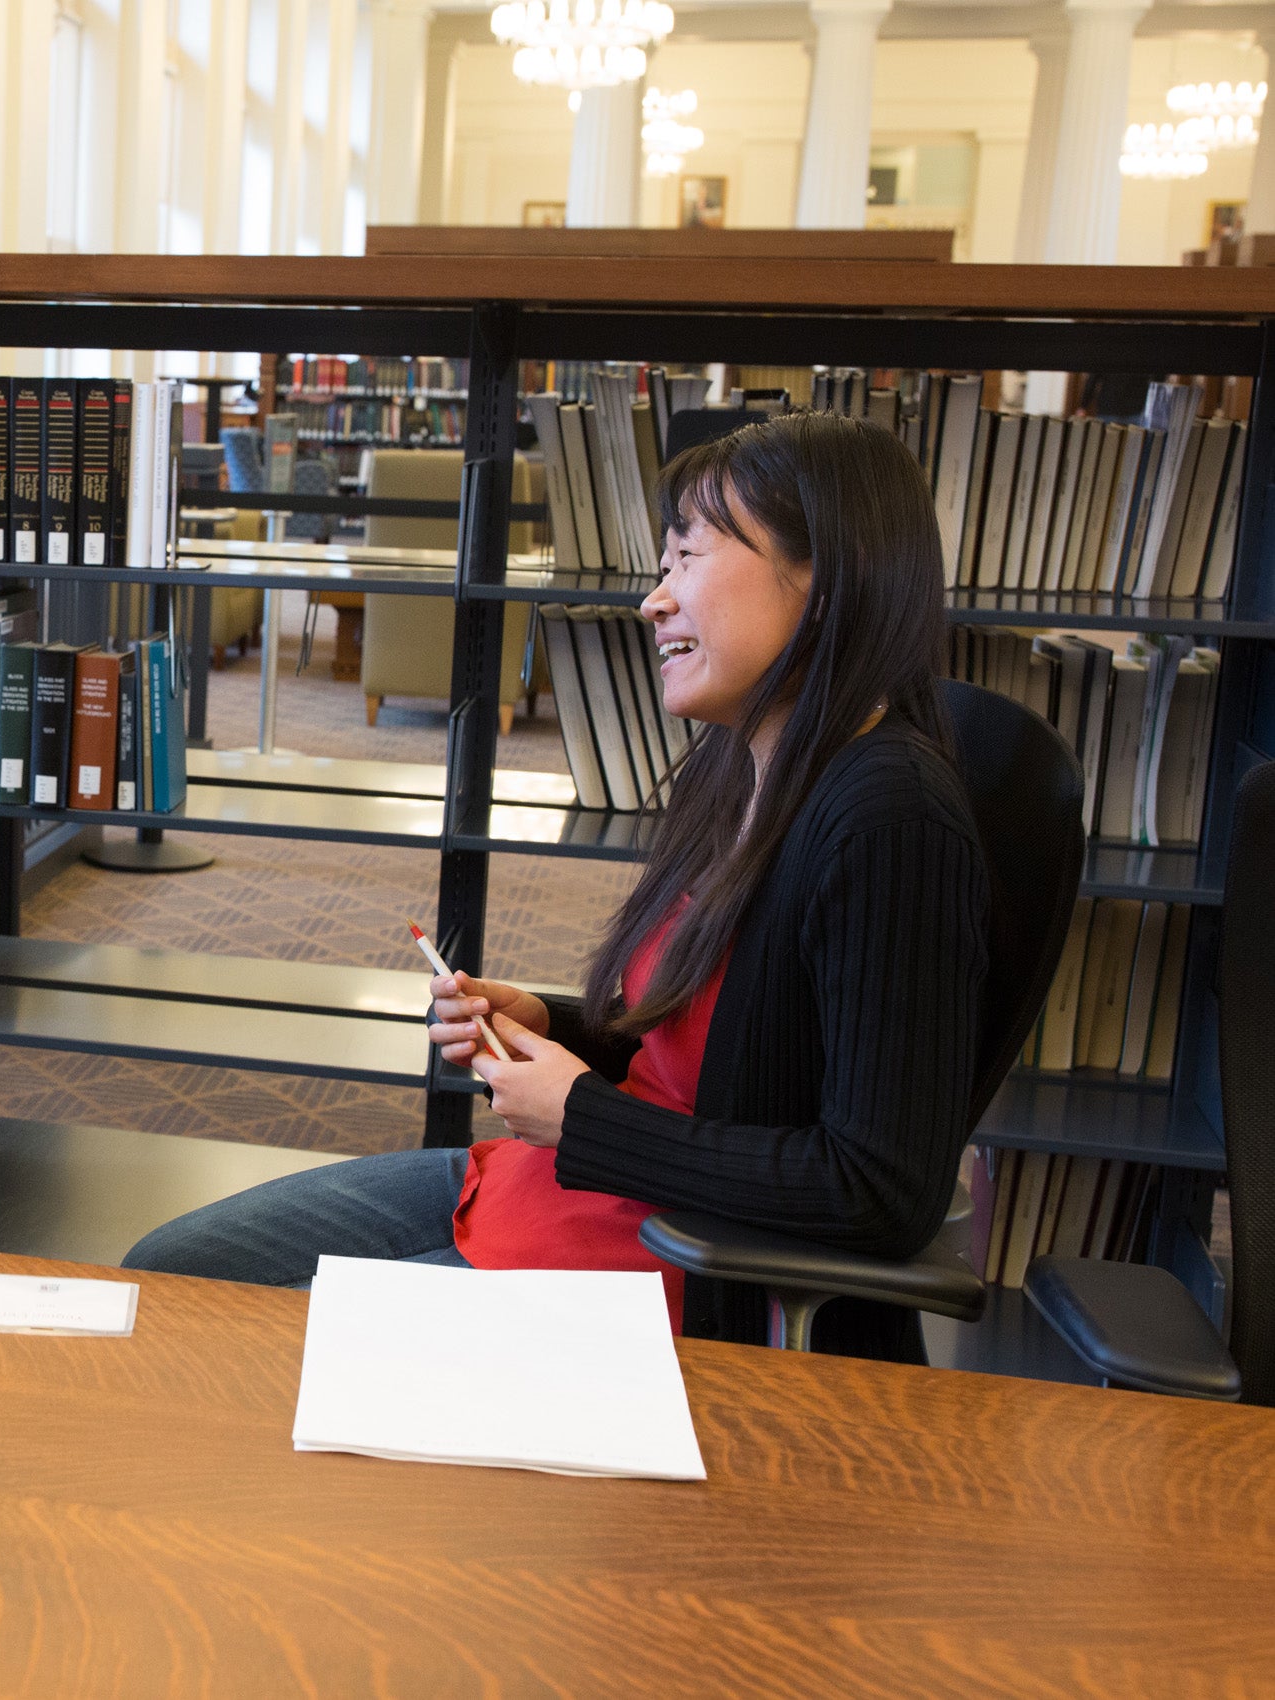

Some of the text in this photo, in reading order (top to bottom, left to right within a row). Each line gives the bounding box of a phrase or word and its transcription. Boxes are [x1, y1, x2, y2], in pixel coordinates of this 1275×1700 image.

[22, 521, 29, 531] 8
[55, 523, 62, 532] 9
[89, 523, 101, 531] 10
